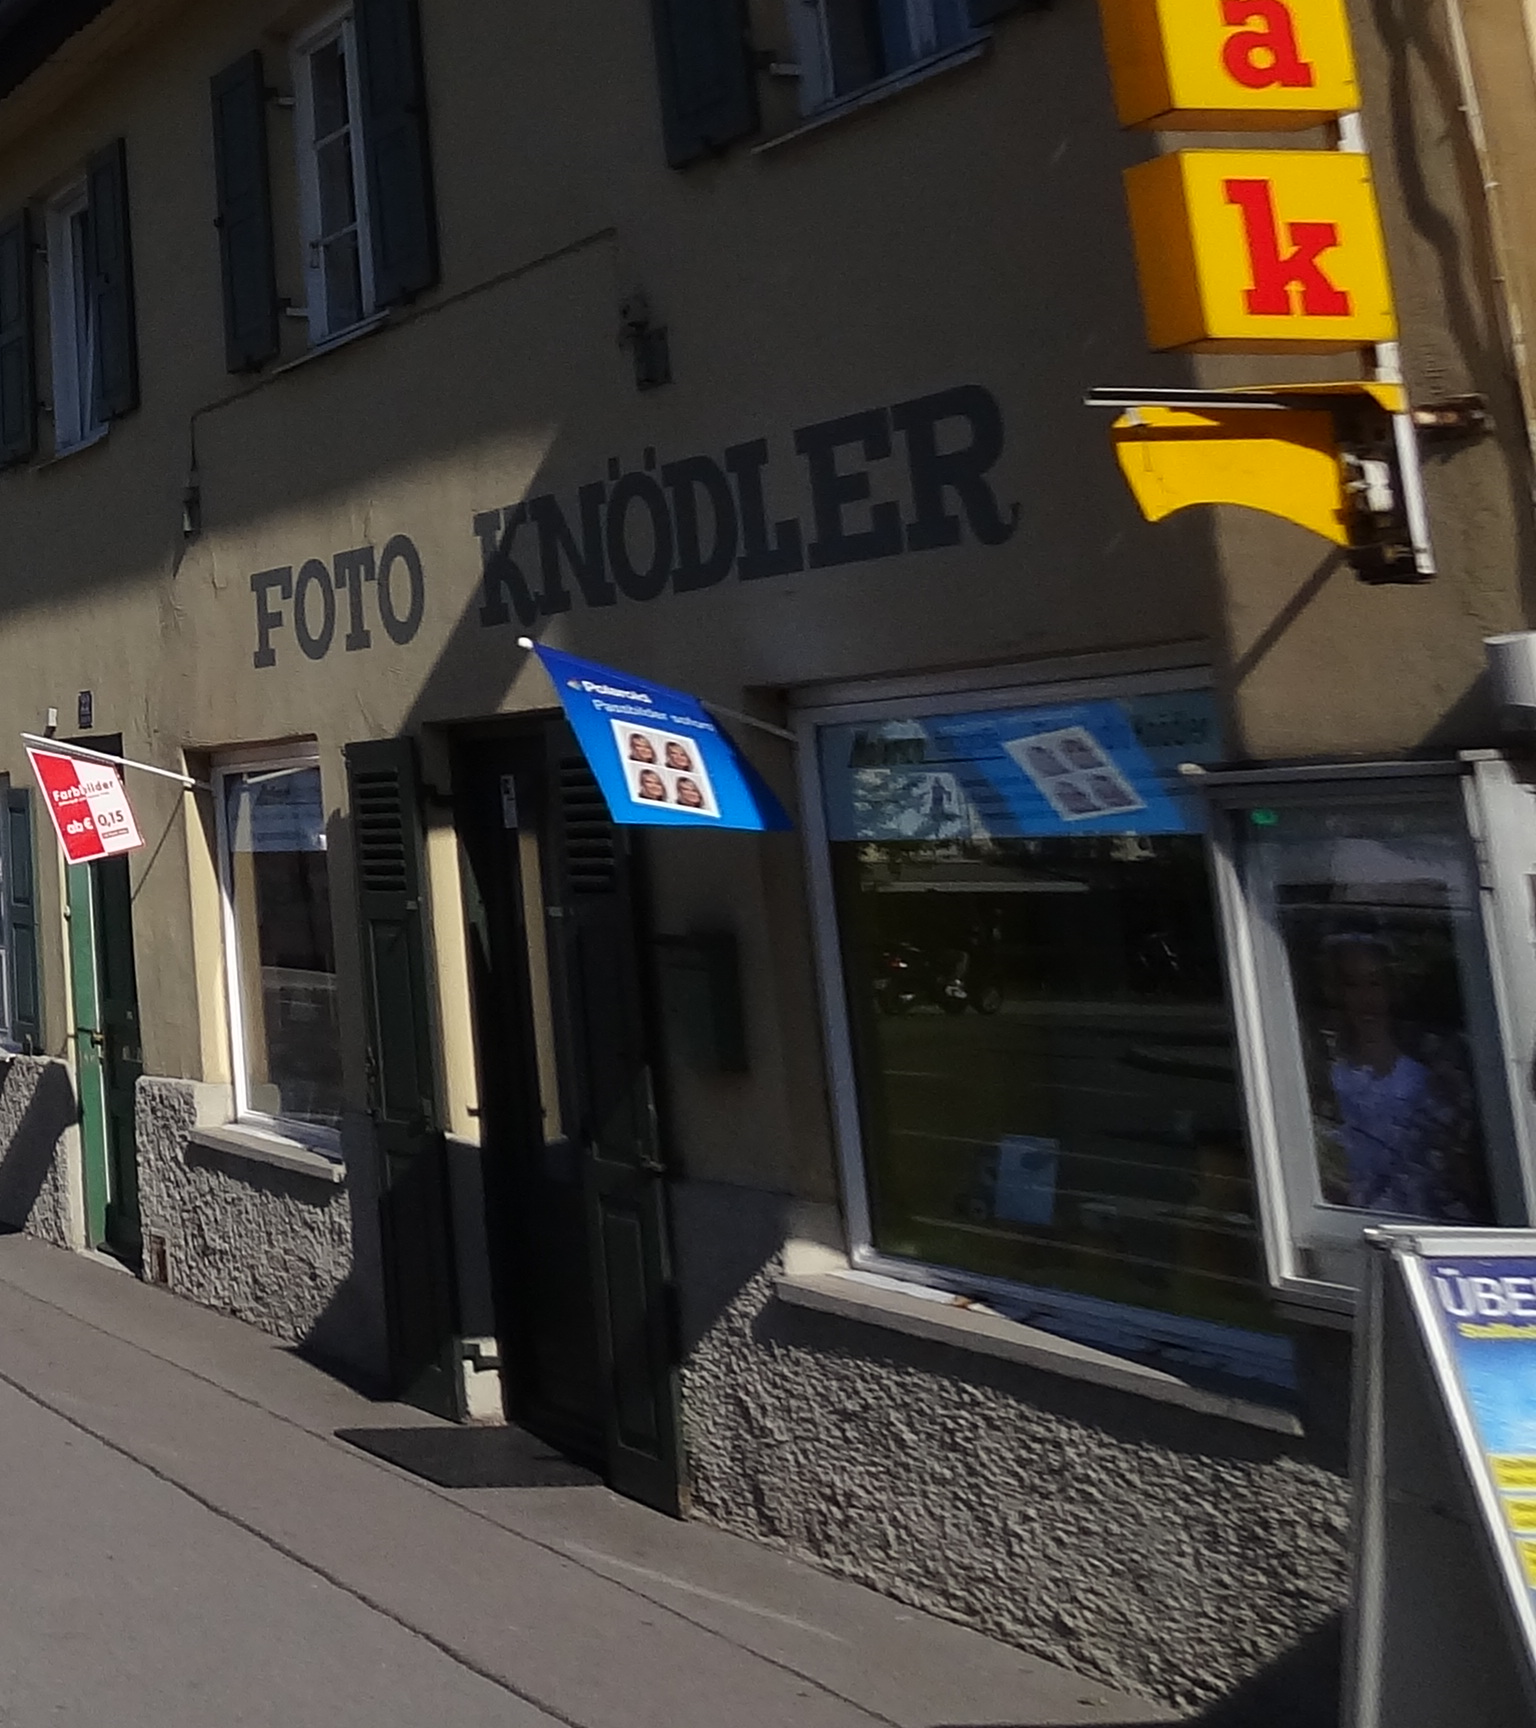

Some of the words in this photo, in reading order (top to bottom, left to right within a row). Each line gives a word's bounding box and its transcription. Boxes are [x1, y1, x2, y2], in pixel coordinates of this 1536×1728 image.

[250, 533, 424, 669] FOTO
[472, 384, 1023, 628] KNÖDLER
[581, 680, 653, 703] Polaroid
[52, 780, 114, 802] Farbbilder
[66, 819, 84, 835] ab
[83, 816, 94, 830] €
[97, 810, 125, 828] 0,15
[1432, 1266, 1536, 1317] ÜBE
